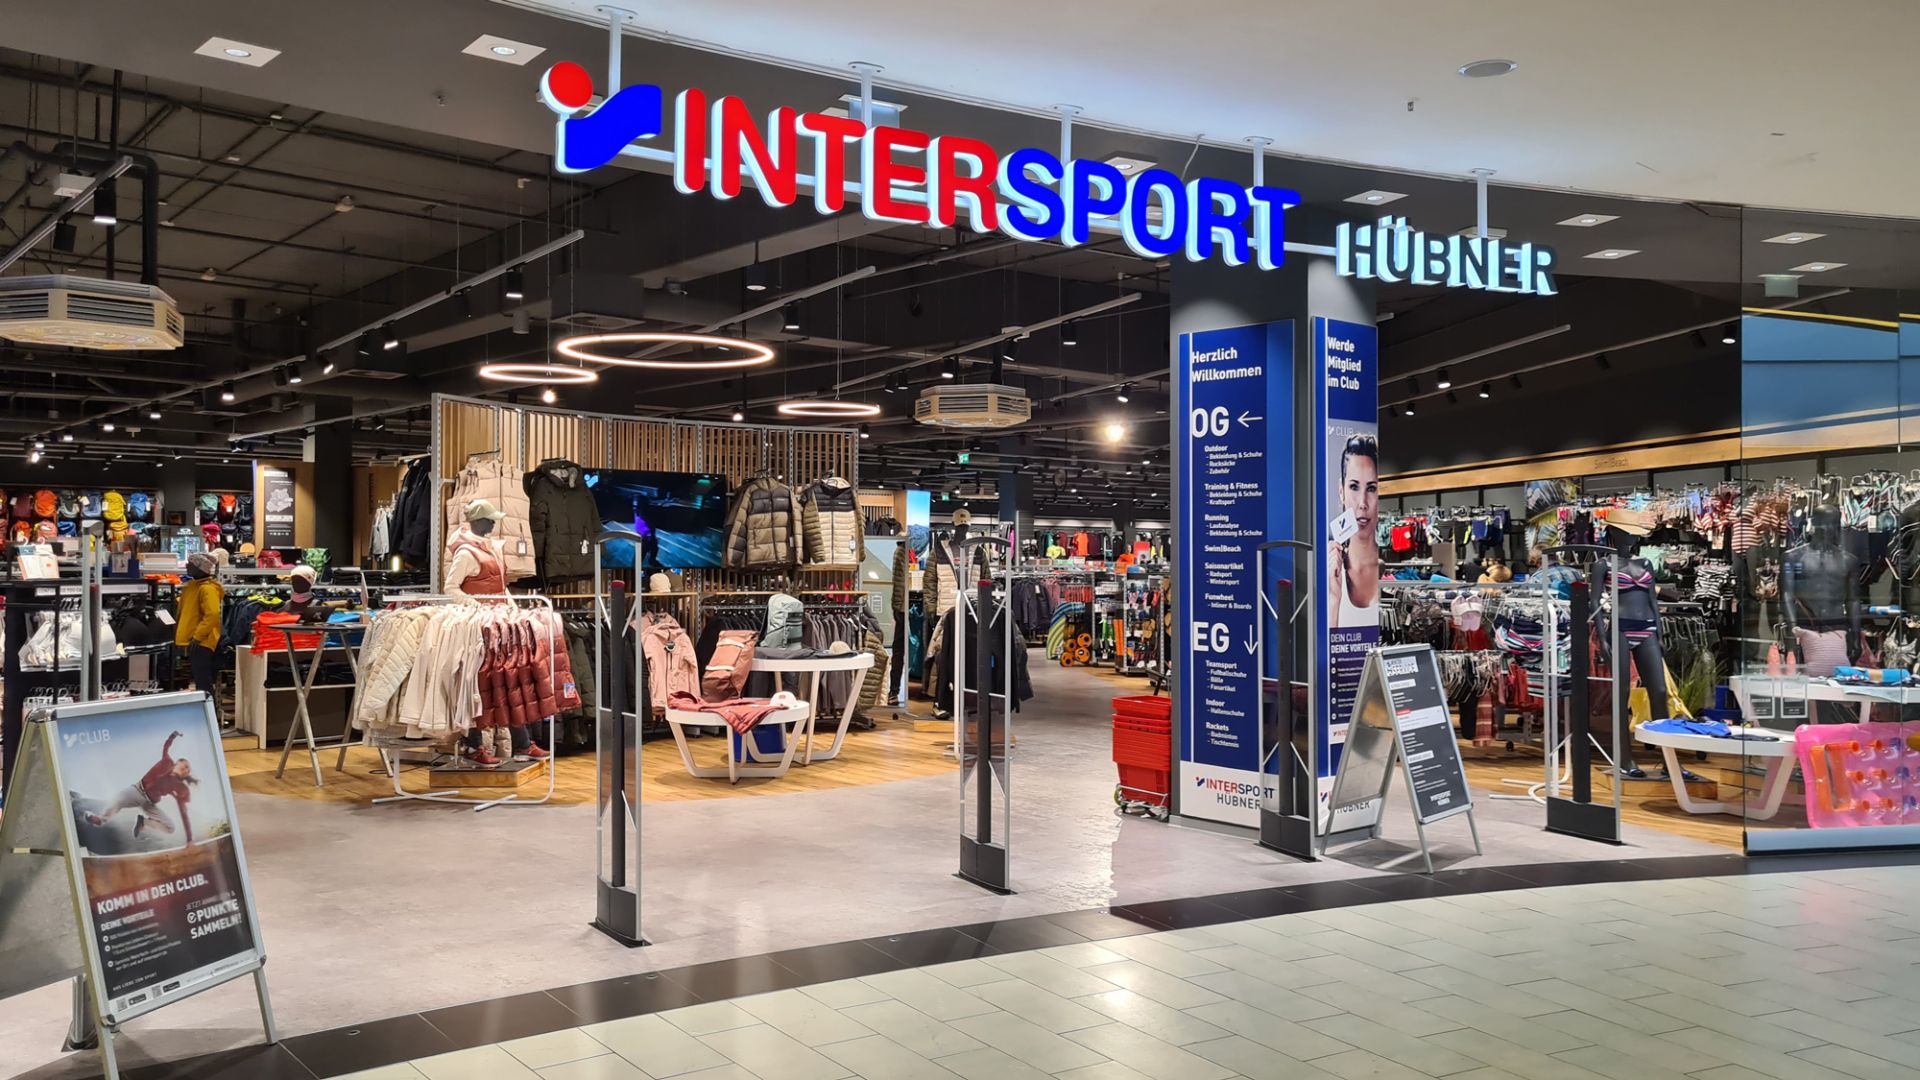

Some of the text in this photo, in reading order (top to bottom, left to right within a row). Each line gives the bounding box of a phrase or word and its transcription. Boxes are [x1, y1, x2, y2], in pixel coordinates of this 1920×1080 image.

[674, 87, 1559, 296] INTERSPORT HÜBNER
[1328, 337, 1355, 352] Werde
[1192, 347, 1238, 363] Herzlich
[1328, 356, 1362, 372] Mitglied
[1192, 366, 1262, 382] Willkommen
[1328, 374, 1360, 390] im Club
[1192, 406, 1229, 438] OG
[1204, 483, 1229, 491] Training
[1204, 514, 1229, 522] Running
[1204, 562, 1244, 570] Saisonartikel
[1193, 621, 1230, 653] EG
[1331, 632, 1362, 643] DEIN CLUB
[1331, 644, 1349, 654] DEINE
[1206, 660, 1237, 669] Teamsport
[1205, 698, 1225, 707] Indoor
[1205, 722, 1230, 731] Rackets
[79, 729, 111, 745] CLUB
[1206, 778, 1275, 799] INTERSPORT
[1217, 792, 1261, 810] HÜBNER
[97, 874, 208, 914] KOMM IN DEN CLUB.
[196, 898, 239, 922] PUNKTE
[190, 912, 242, 939] SAMMELN!
